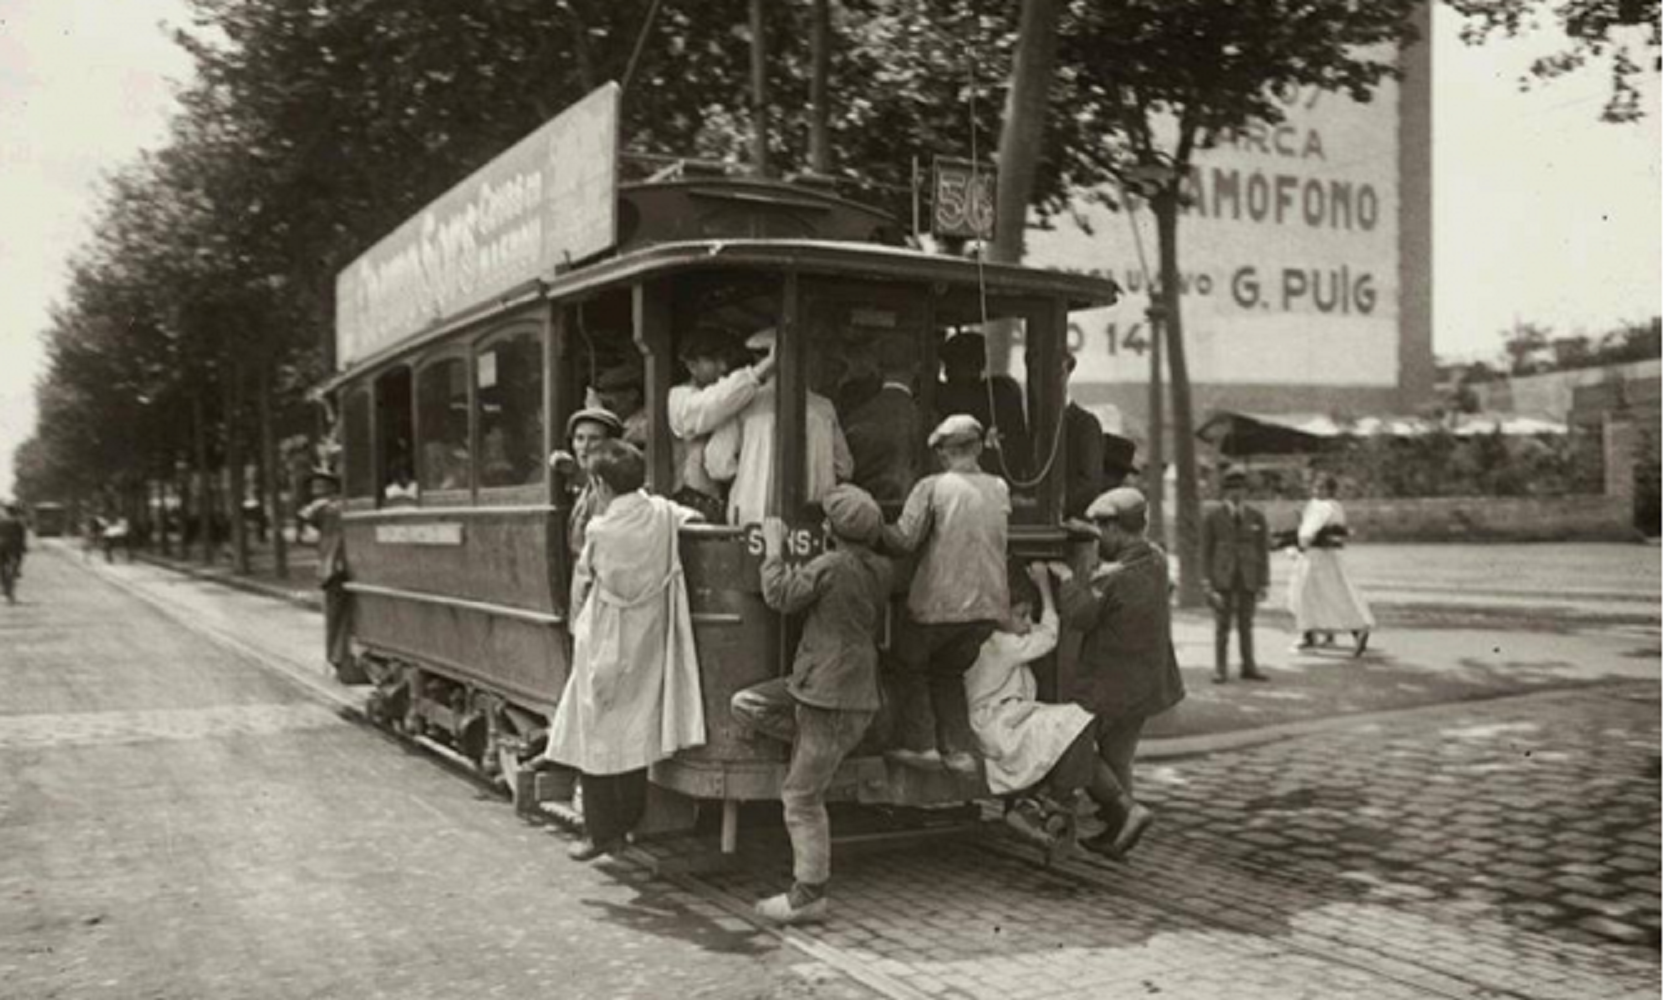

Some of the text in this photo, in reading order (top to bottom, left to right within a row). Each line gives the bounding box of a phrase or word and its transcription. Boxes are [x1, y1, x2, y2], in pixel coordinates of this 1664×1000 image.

[1210, 122, 1327, 161] ARCA
[1231, 265, 1270, 309] G.
[1106, 322, 1152, 356] 14
